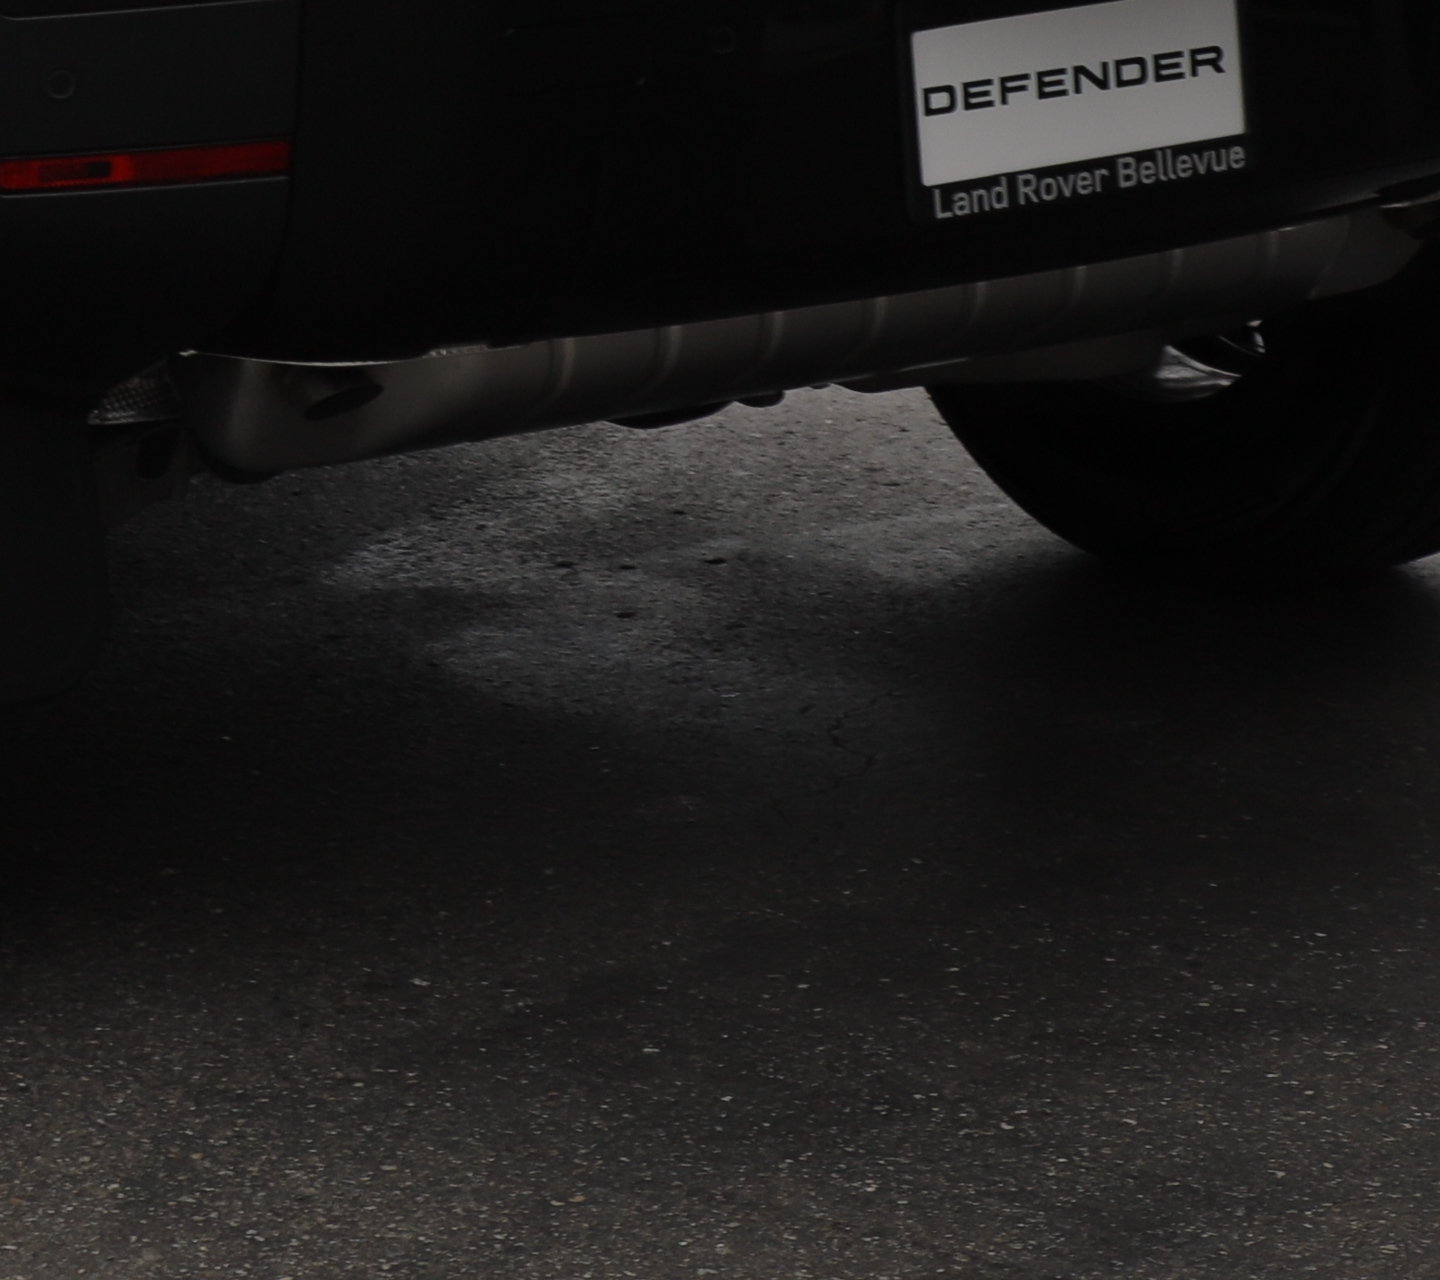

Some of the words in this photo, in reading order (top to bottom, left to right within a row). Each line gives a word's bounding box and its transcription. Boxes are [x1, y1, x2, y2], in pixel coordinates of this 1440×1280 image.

[923, 46, 1226, 117] DEFENDER
[933, 178, 1009, 220] Land
[1017, 166, 1111, 206] Rover
[1117, 143, 1247, 191] Bellevue
